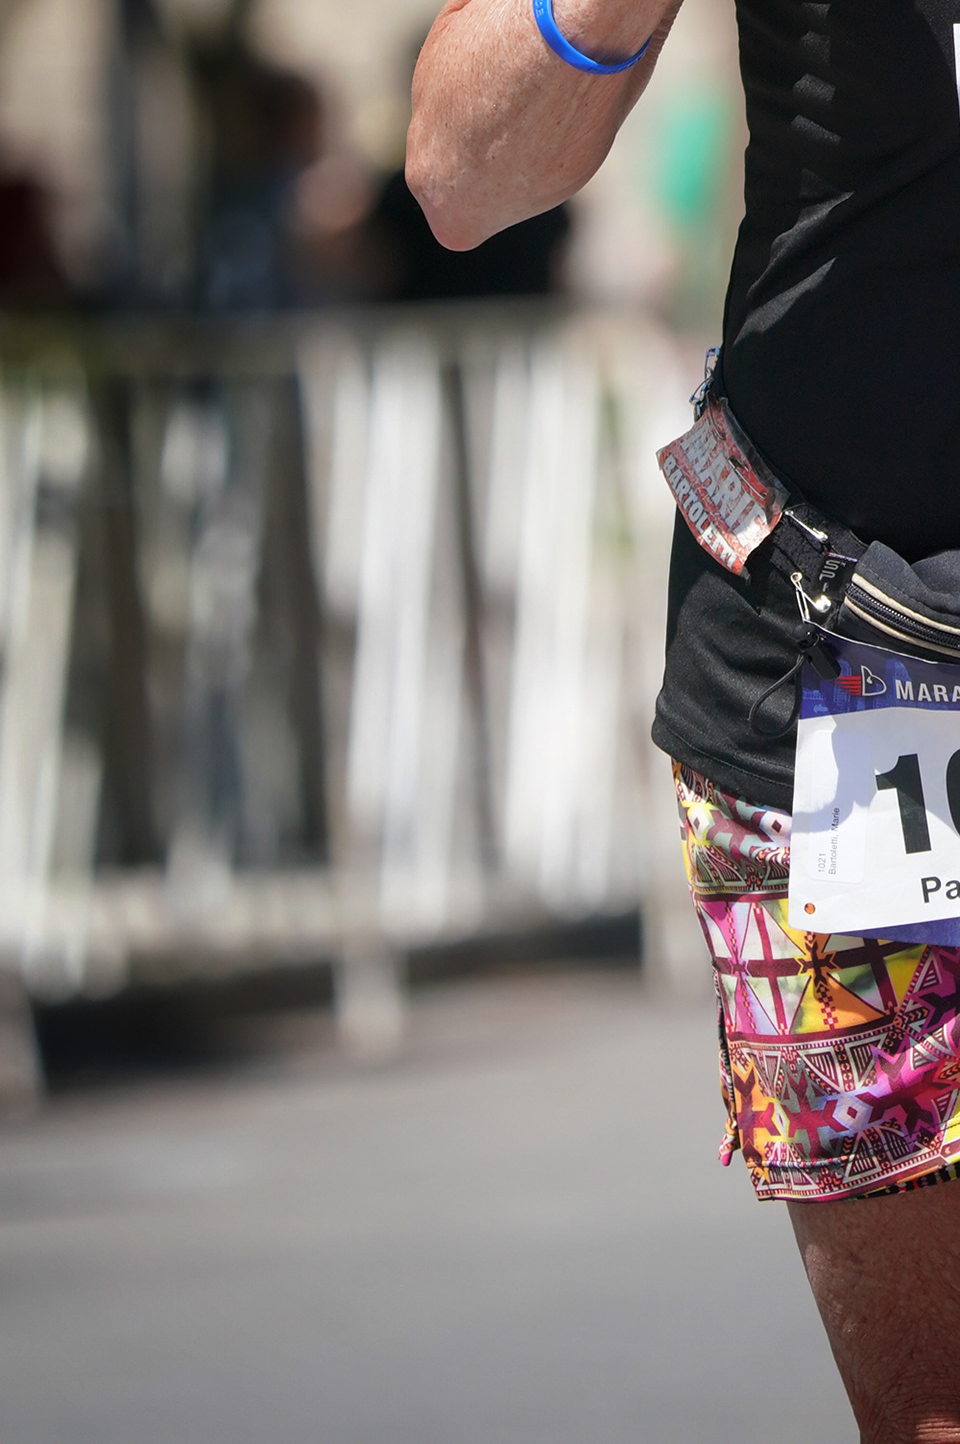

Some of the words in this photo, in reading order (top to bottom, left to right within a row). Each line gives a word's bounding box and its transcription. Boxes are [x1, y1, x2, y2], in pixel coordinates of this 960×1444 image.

[662, 454, 738, 570] BARTOLETTI
[831, 807, 840, 832] Marie
[817, 853, 826, 873] 1021
